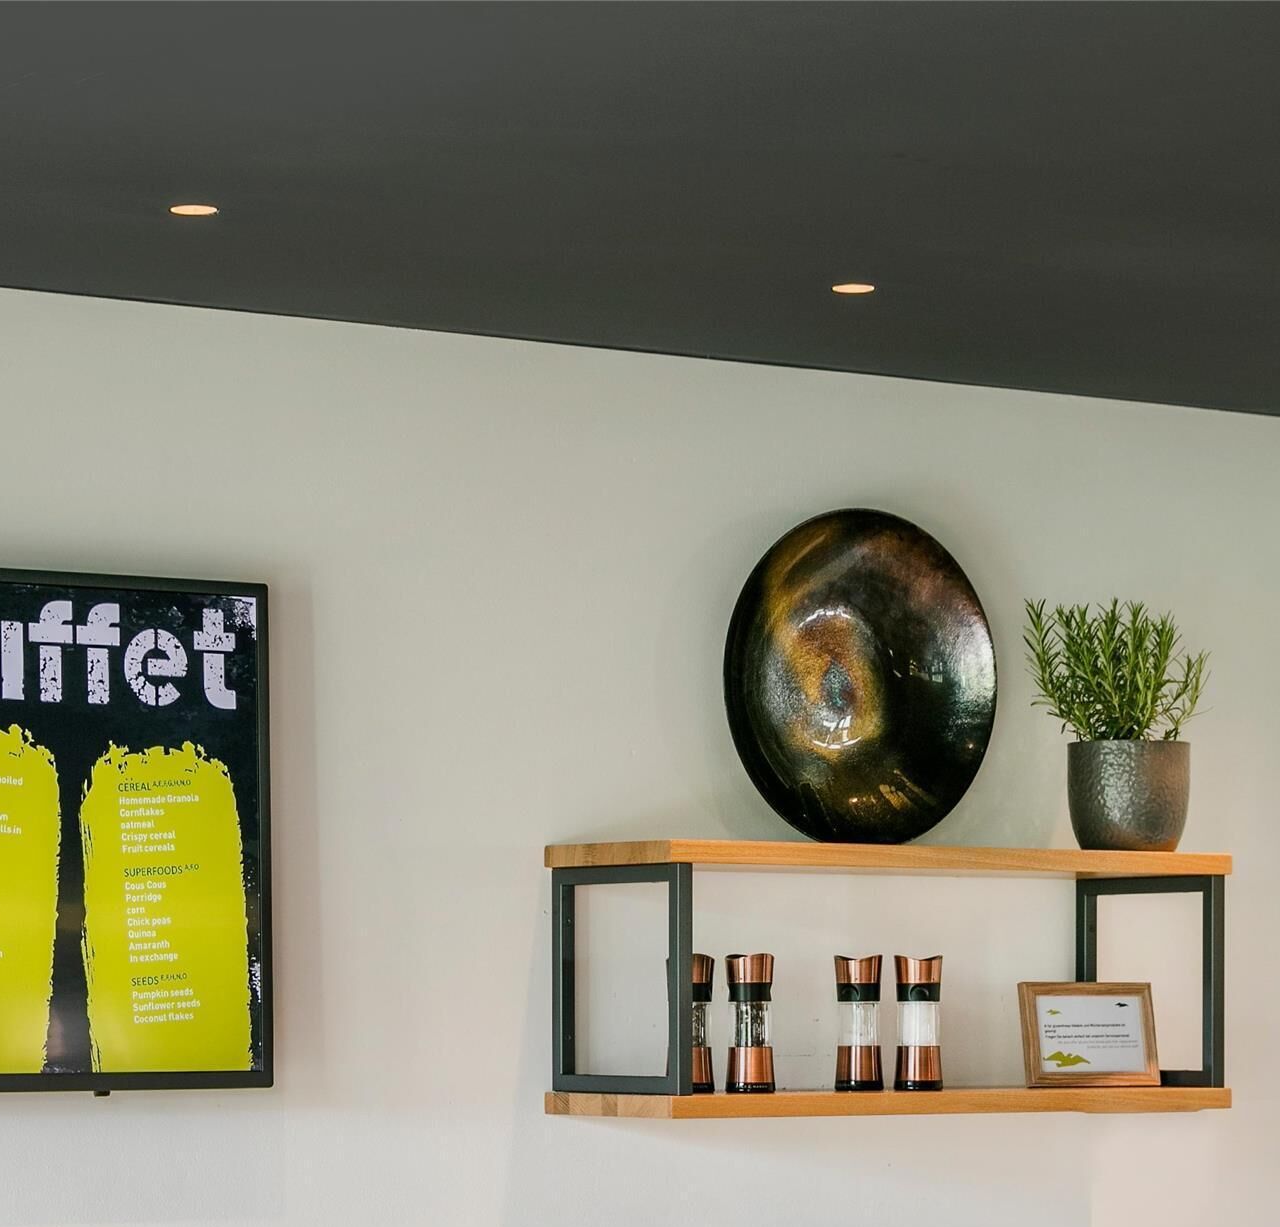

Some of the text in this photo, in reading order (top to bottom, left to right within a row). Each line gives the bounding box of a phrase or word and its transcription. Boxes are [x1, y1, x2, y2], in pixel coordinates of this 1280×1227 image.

[118, 781, 151, 792] CEREAL
[119, 794, 199, 804] Homemade Granola
[120, 806, 165, 817] Cornflakes
[121, 820, 154, 829] oatmeal
[121, 830, 176, 842] Crispy cereal
[122, 842, 175, 853] Fruit cereals
[124, 865, 182, 877] SUPERFOODS
[125, 880, 167, 890] Cous Cous
[126, 892, 162, 904] Porridge
[127, 905, 145, 914] corn
[128, 916, 171, 926] Chick peas
[128, 929, 156, 939] Quinoa
[139, 951, 178, 962] exchange
[132, 975, 159, 986] SEEDS
[132, 986, 193, 1001] Pumpkin seeds
[133, 998, 200, 1011] Sunflower seeds
[134, 1010, 193, 1023] Coconut flakes
